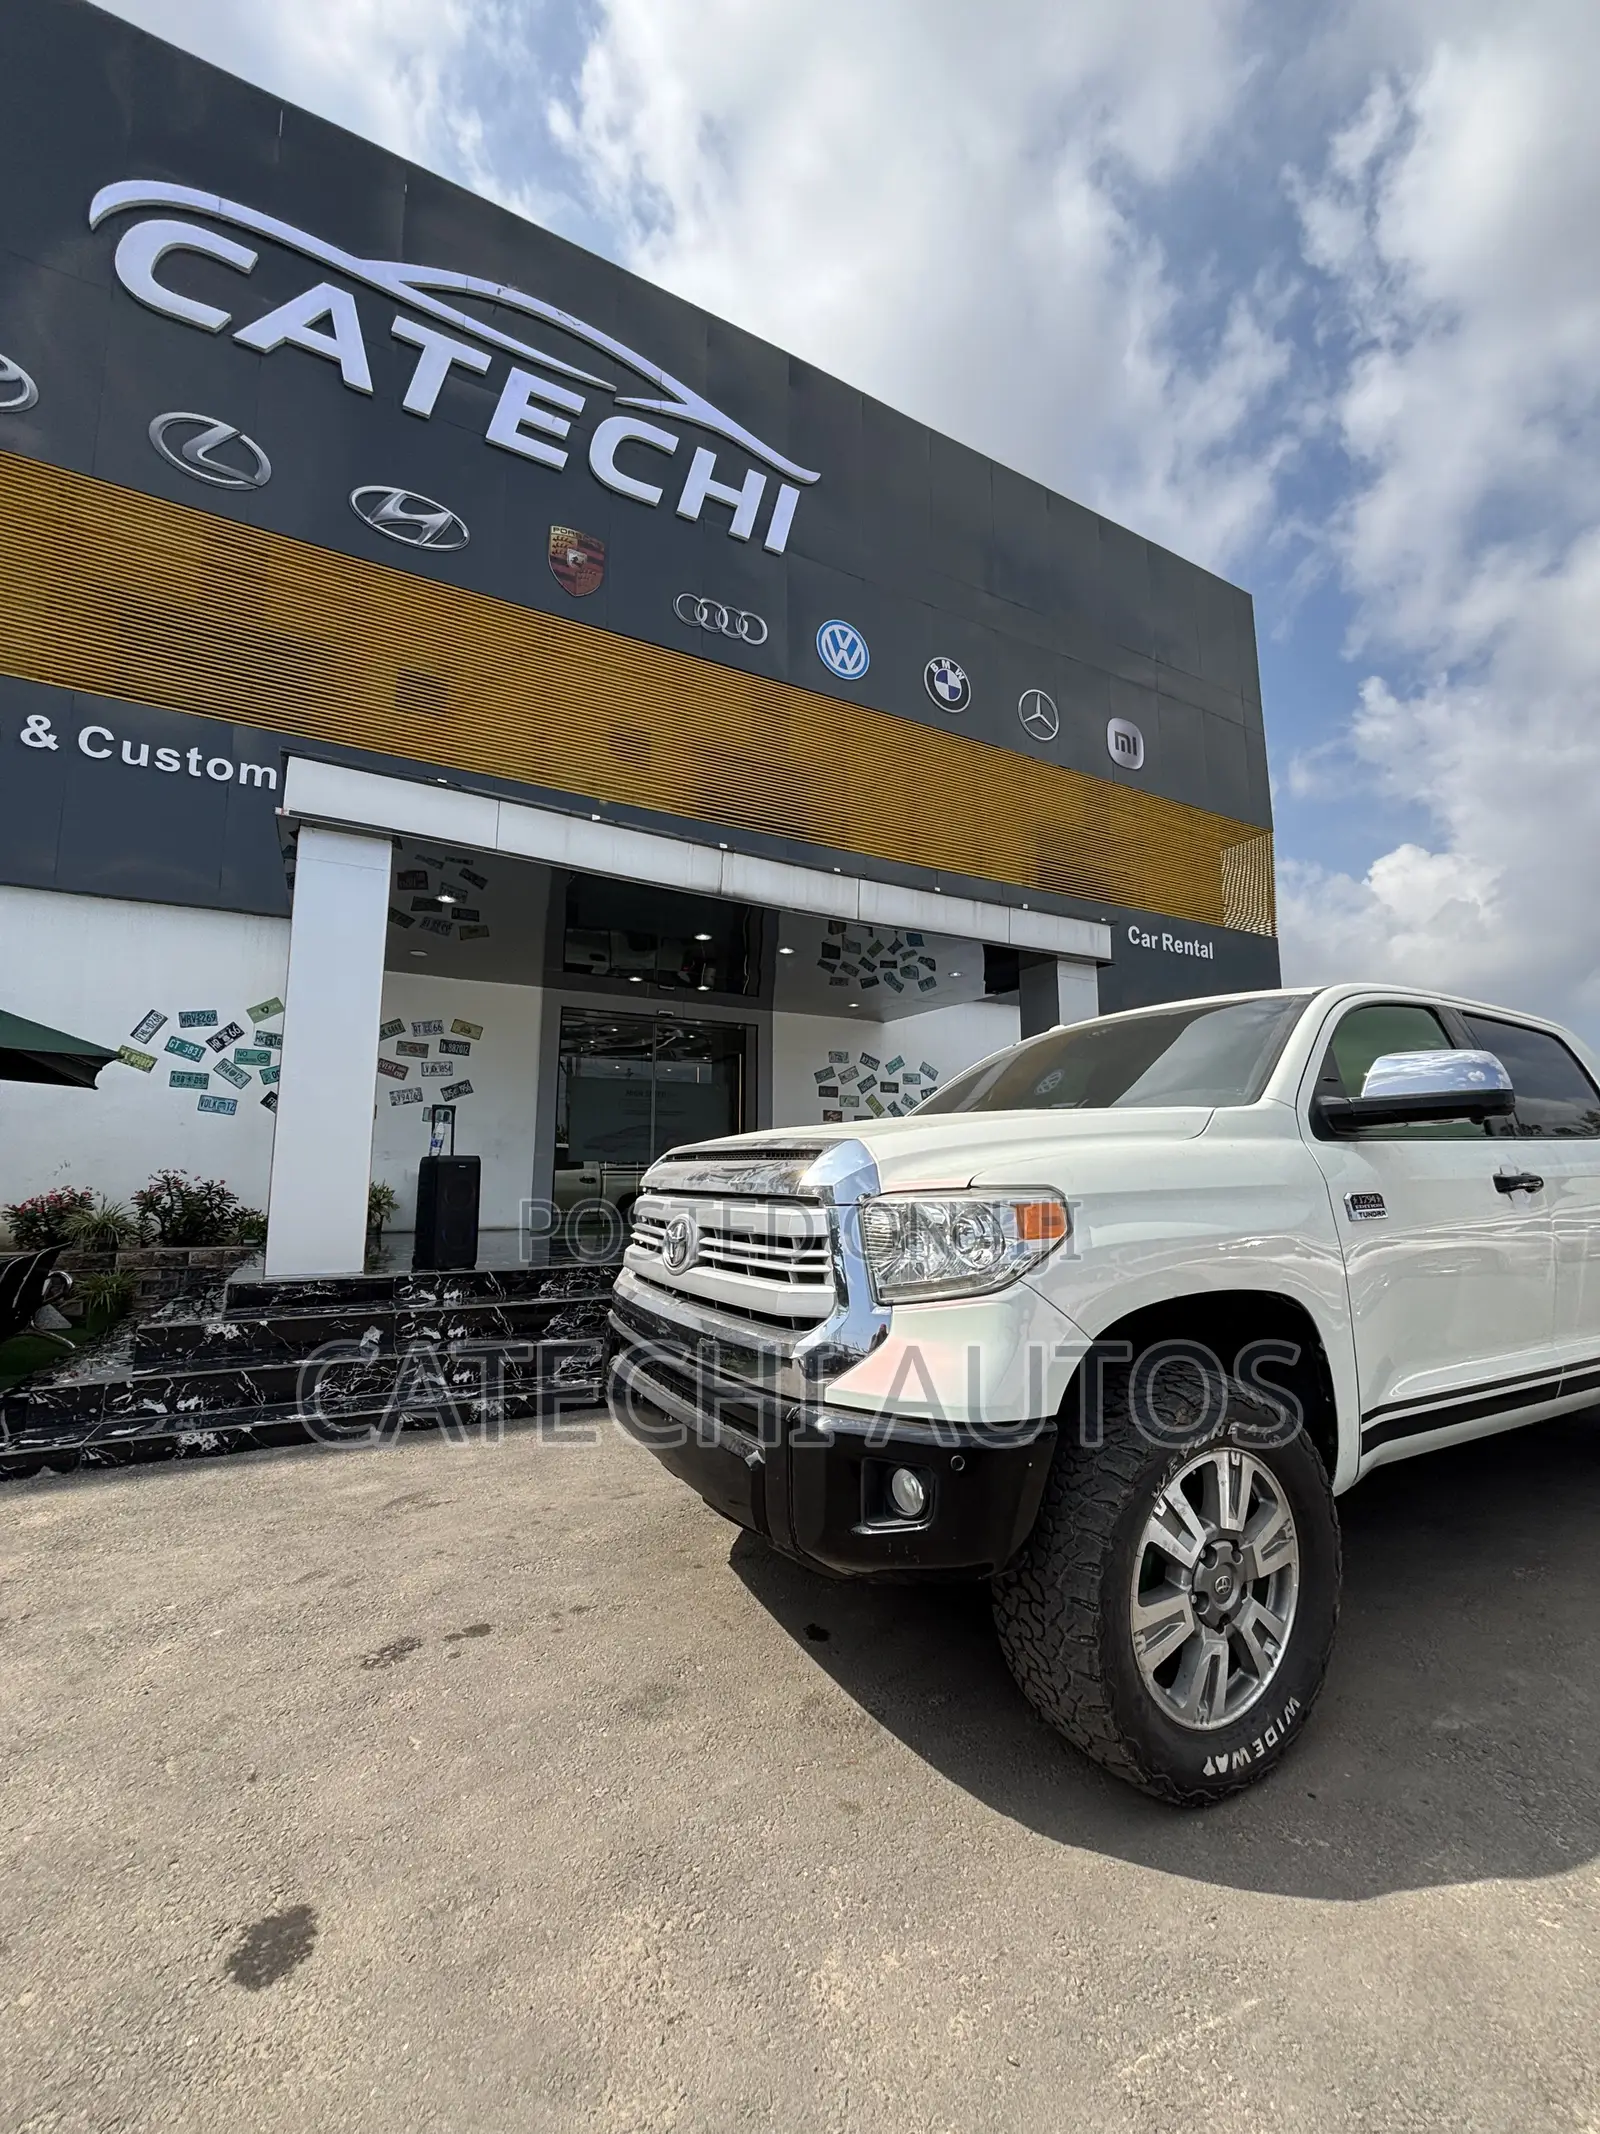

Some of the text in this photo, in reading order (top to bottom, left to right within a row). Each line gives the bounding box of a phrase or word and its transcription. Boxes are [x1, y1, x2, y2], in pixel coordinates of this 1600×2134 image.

[114, 218, 800, 556] CATECHI
[930, 659, 965, 681] BMW
[20, 714, 278, 790] & Custom
[1127, 925, 1214, 959] Car Rental
[168, 1037, 183, 1050] GT
[1358, 1210, 1386, 1218] TUNDRA
[1202, 1696, 1301, 1777] WIDEWAY
